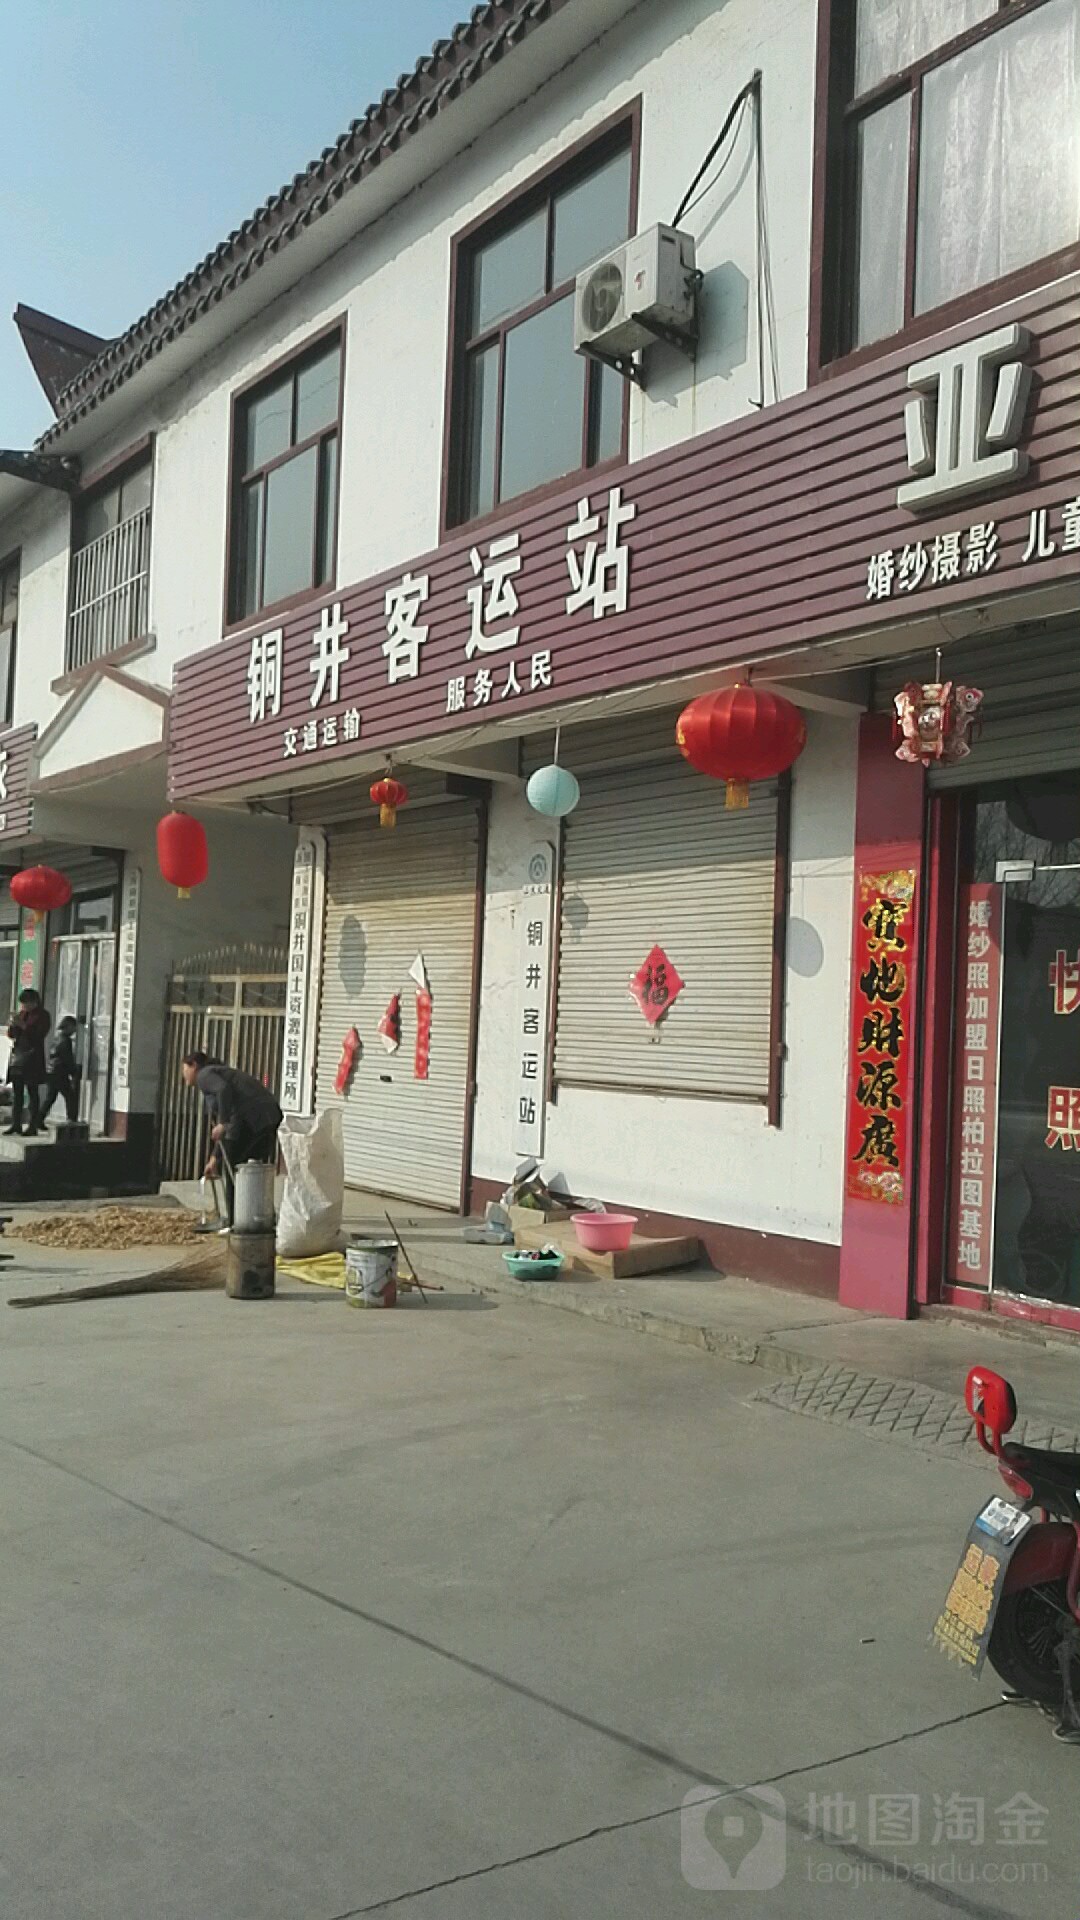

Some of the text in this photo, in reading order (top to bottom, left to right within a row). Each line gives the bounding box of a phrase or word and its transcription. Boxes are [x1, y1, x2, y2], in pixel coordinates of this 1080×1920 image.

[897, 322, 1032, 509] 亚
[247, 487, 637, 724] 铜井客运站
[866, 521, 999, 599] 婚纱摄影
[283, 708, 362, 758] 交通运输
[446, 649, 553, 713] 服务人民
[283, 911, 307, 1100] 铜井国土资源管理所
[519, 921, 543, 1124] 铜井客运站
[641, 963, 669, 1006] 福
[957, 900, 992, 1270] 婚纱照加盟日照柏拉图基地
